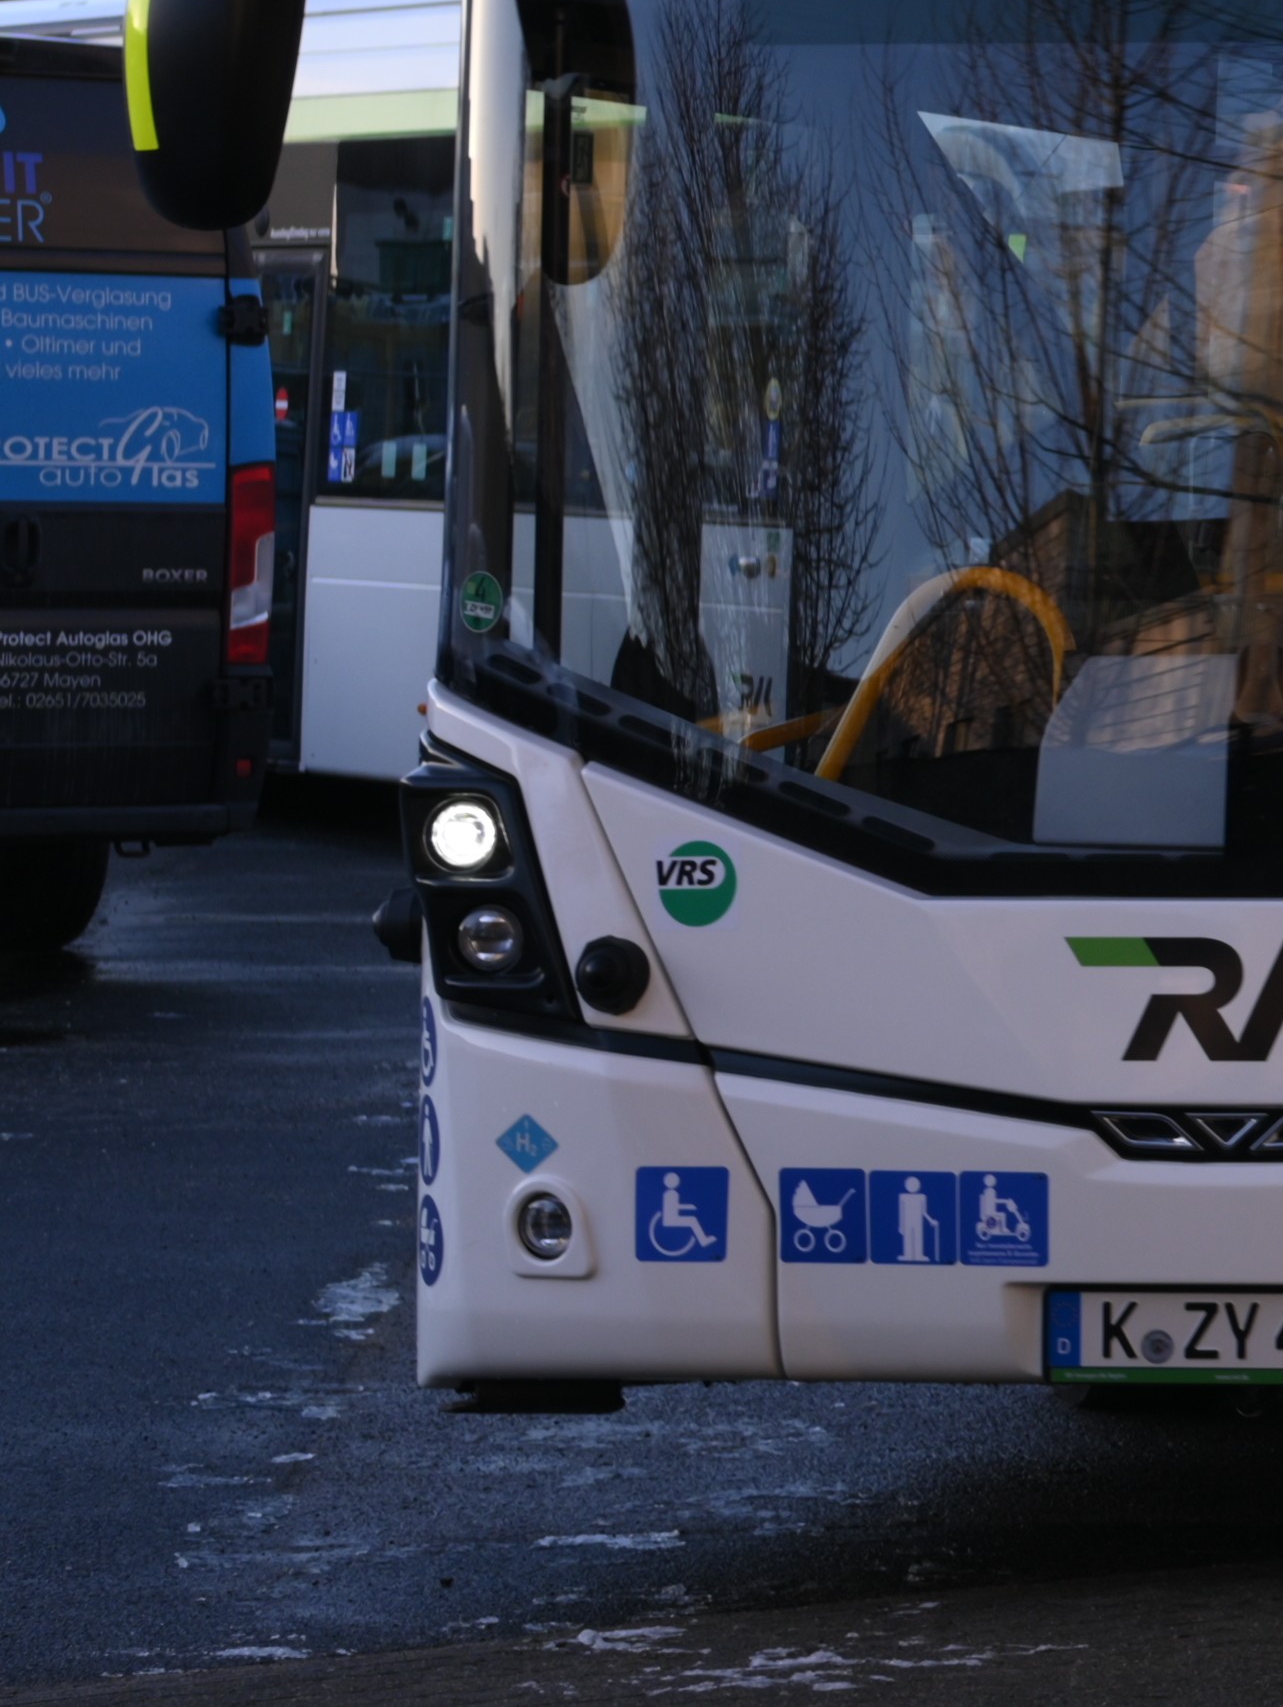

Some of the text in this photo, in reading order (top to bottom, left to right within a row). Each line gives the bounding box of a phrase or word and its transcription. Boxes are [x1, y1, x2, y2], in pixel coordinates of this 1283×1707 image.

[12, 283, 172, 310] BUS-Verglasung
[1, 308, 153, 330] Baumaschinen
[102, 338, 141, 356] und
[5, 360, 121, 381] vieles mehr
[142, 568, 208, 583] BOXER
[56, 630, 128, 649] Autoglas
[132, 629, 172, 646] OHG
[137, 651, 157, 667] 5a
[0, 672, 101, 691] 6727 Mayen
[25, 693, 146, 711] 02651/7035025
[656, 859, 717, 887] VRS
[1102, 1301, 1139, 1360] K
[1184, 1301, 1260, 1360] ZY
[1056, 1337, 1072, 1355] D
